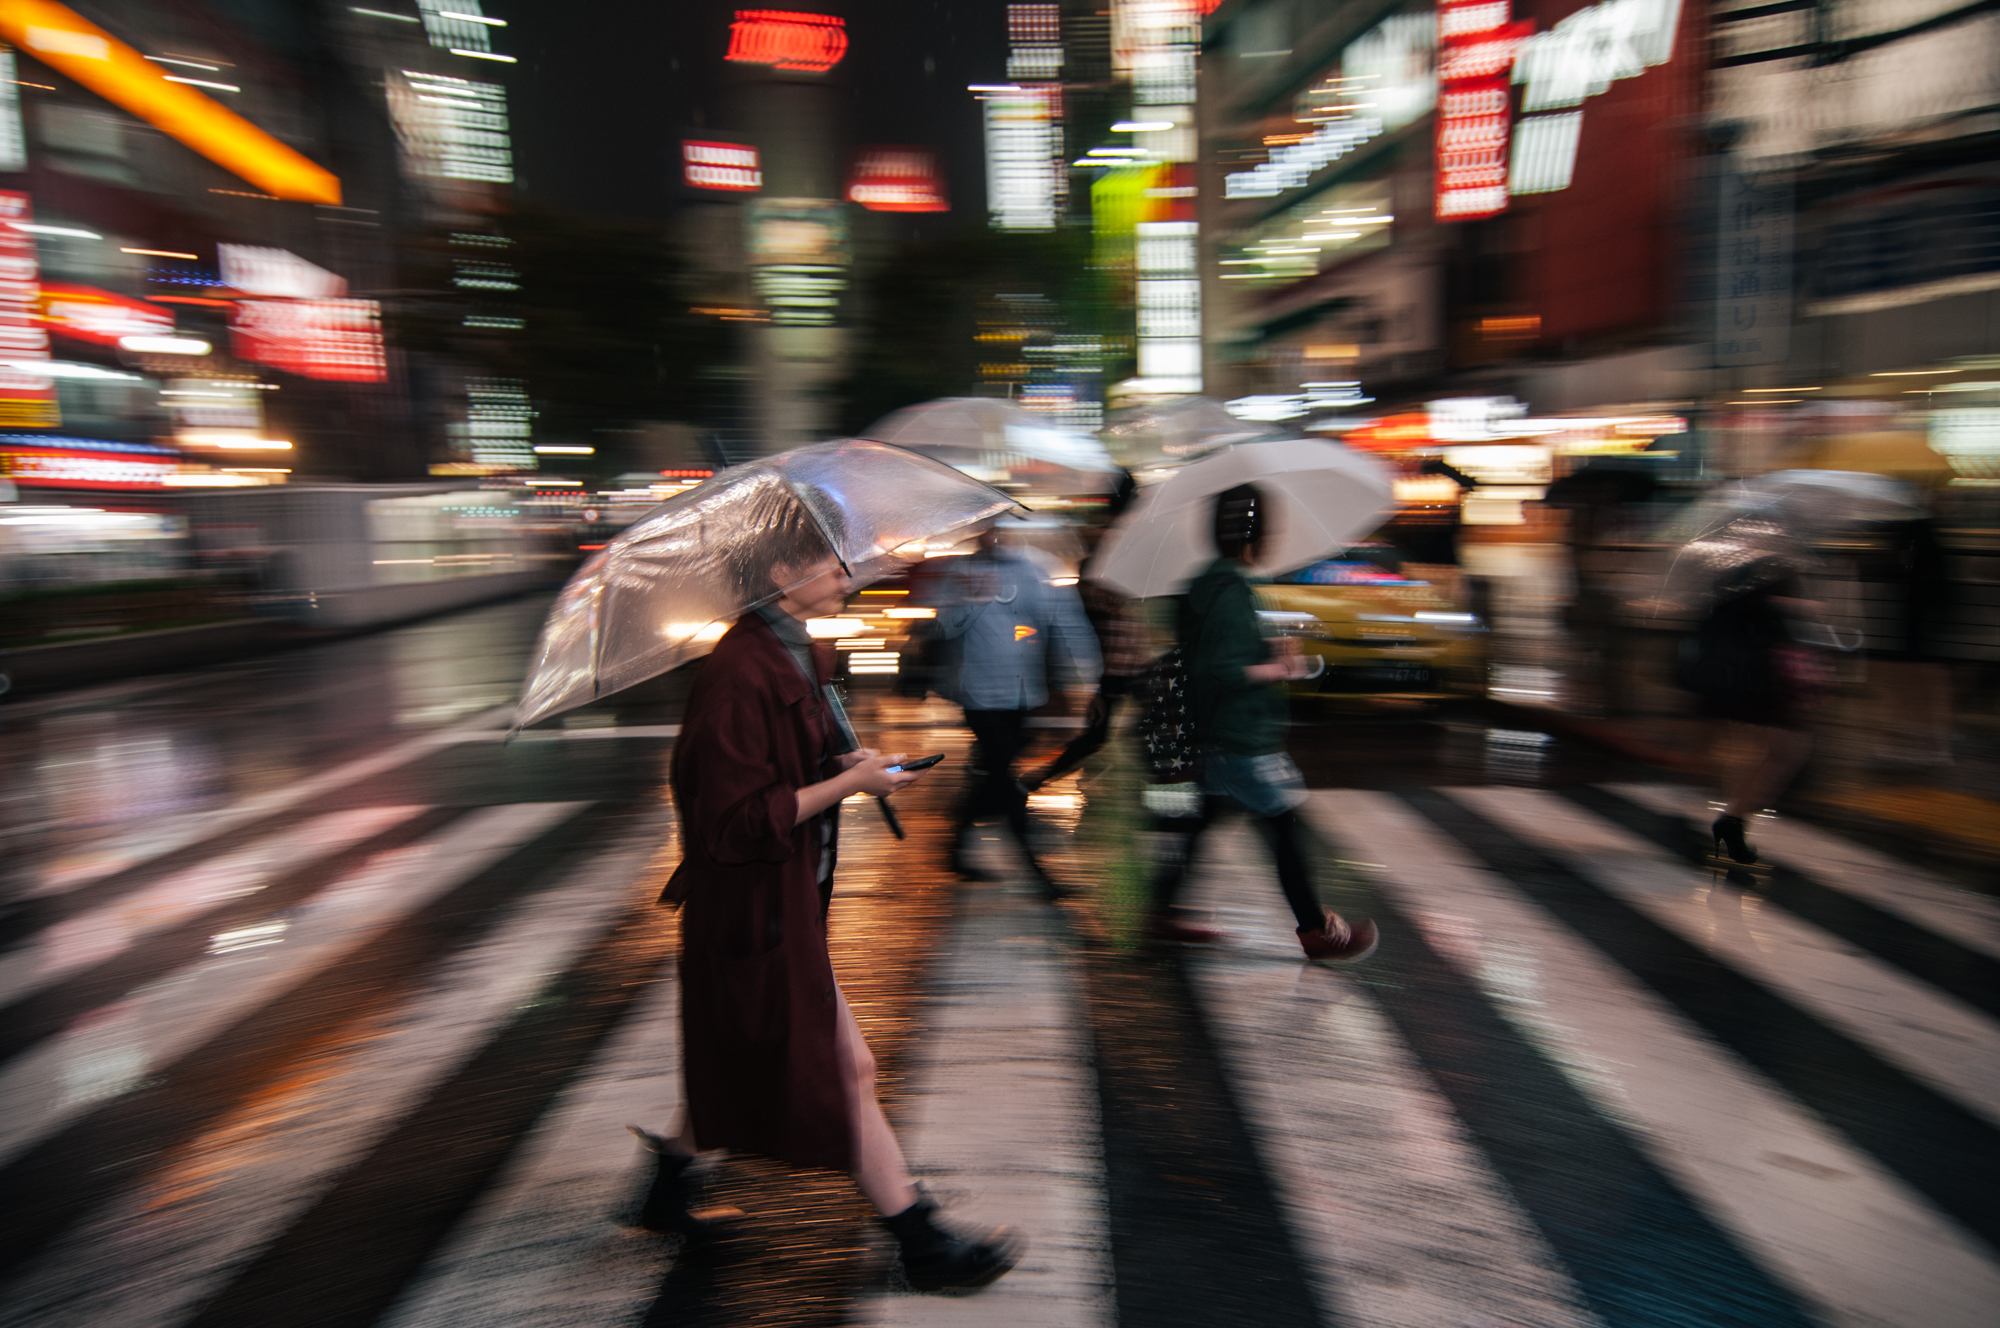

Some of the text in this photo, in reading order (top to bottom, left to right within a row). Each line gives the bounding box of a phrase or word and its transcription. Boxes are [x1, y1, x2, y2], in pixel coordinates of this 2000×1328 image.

[1730, 173, 1764, 332] 文化村通り
